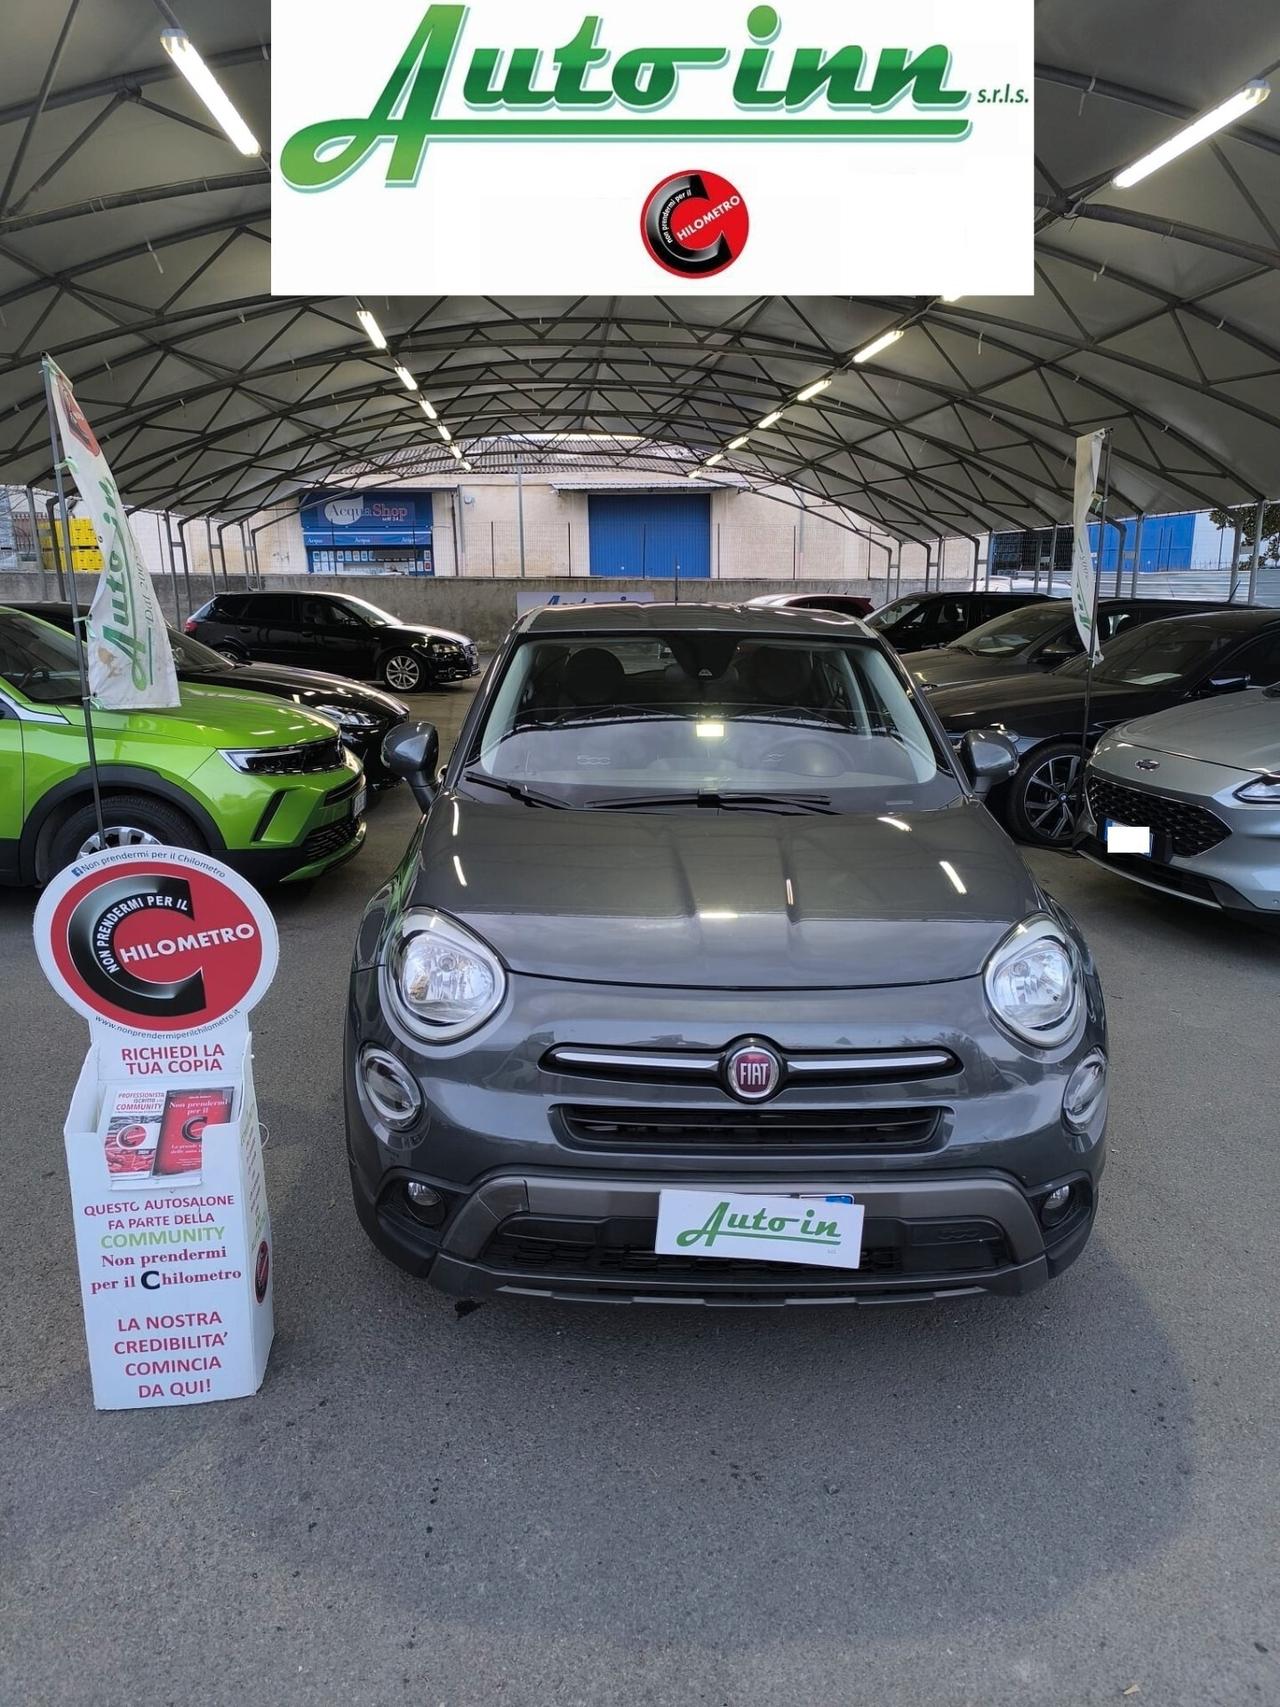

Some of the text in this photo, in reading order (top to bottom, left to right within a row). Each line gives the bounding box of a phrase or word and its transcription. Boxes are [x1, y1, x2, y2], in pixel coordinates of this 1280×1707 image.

[329, 503, 408, 521] Acqua Shop
[102, 549, 147, 692] Auto
[82, 851, 226, 878] Non prendermi per il Chilometro
[97, 895, 188, 974] NON PRENDERMI PER IL
[95, 1008, 241, 1040] www.nonprendermiperilchilometro.it
[121, 1043, 225, 1061] RICHIEDI LA
[126, 1057, 222, 1075] TUA COPIA
[740, 1062, 769, 1085] FIAT
[169, 1099, 228, 1109] Non prendermi
[84, 1195, 235, 1217] QUESTO AUTOSALONE
[108, 1213, 215, 1230] FA PARTE DELLA
[676, 1202, 841, 1247] Auto in
[101, 1226, 226, 1250] COMMUNITY
[101, 1247, 227, 1268] Non prendermi
[91, 1279, 120, 1295] per
[123, 1275, 136, 1289] il
[140, 1269, 242, 1291] Chilometro
[118, 1311, 223, 1332] LA NOSTRA
[125, 1357, 222, 1377] COMINCIA
[138, 1379, 212, 1398] DA QUI!
